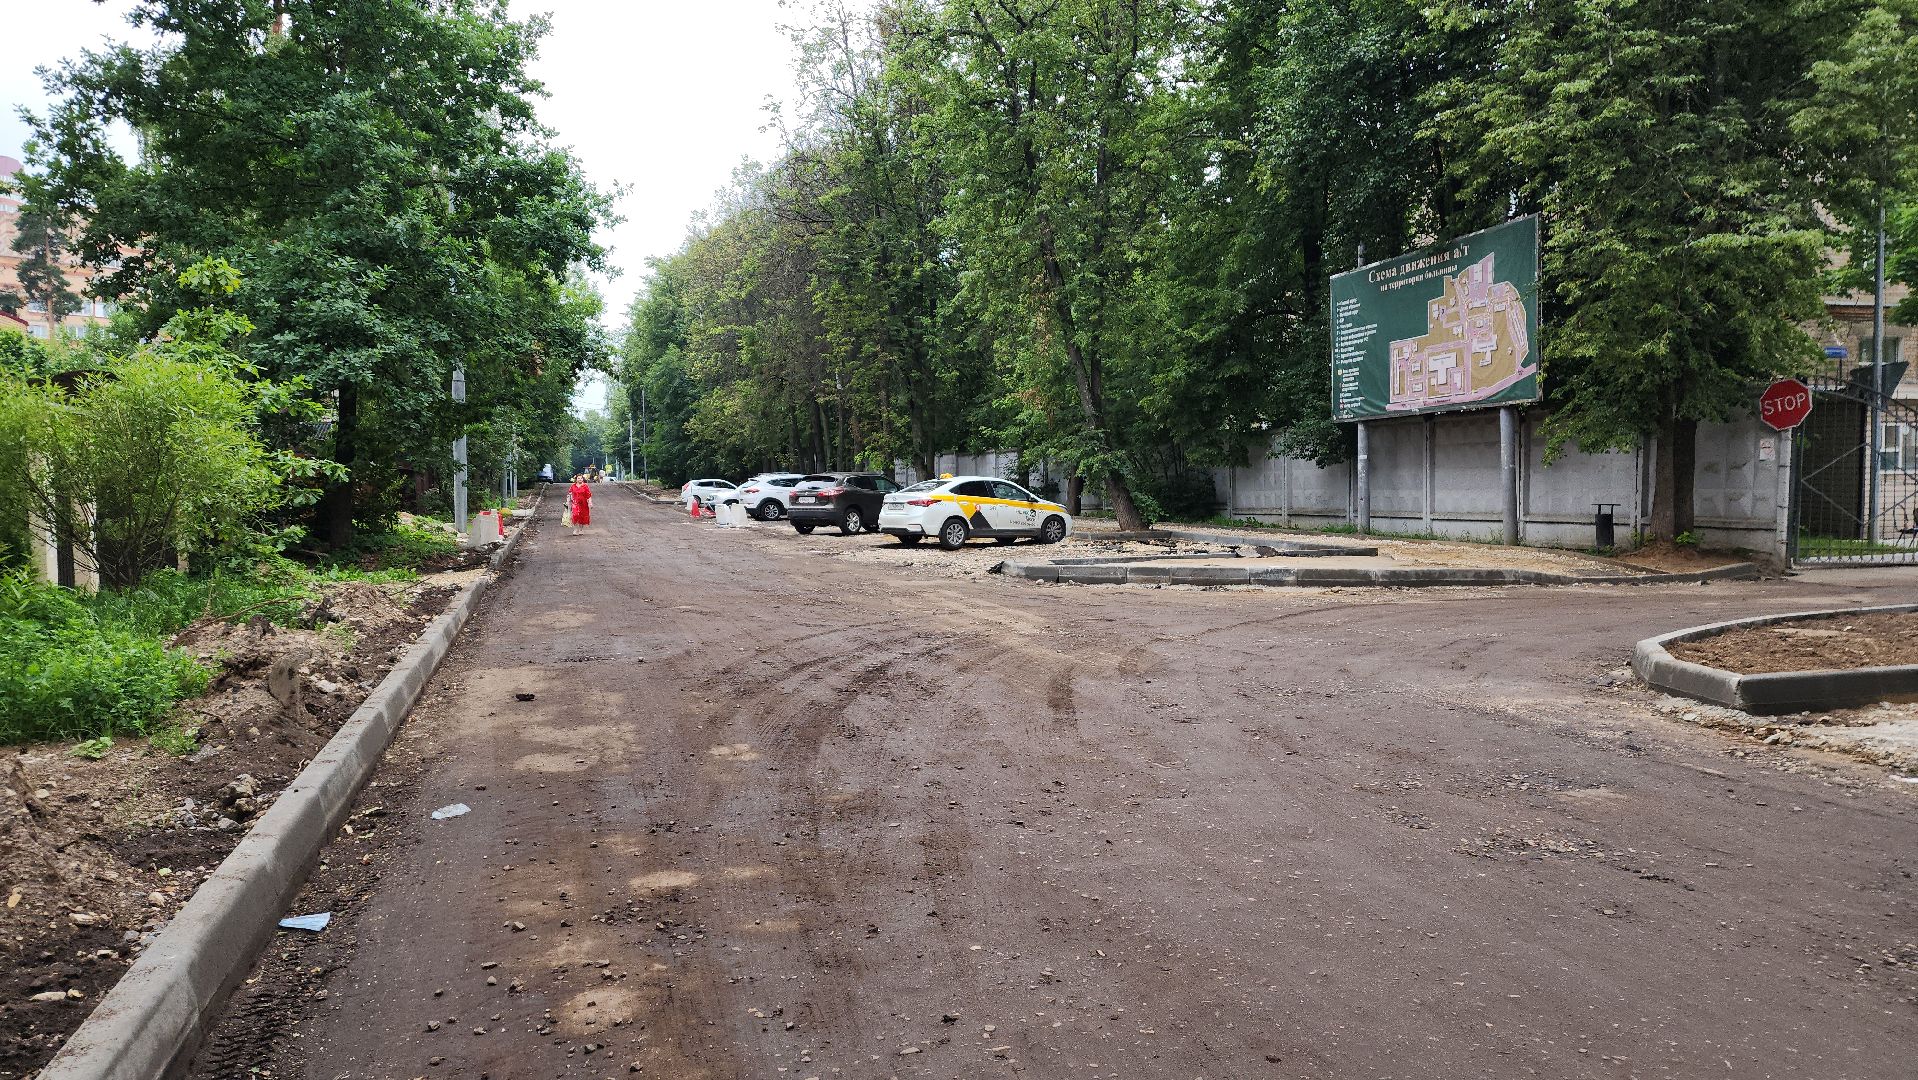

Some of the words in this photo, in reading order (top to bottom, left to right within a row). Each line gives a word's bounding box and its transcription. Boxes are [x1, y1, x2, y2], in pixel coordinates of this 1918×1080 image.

[1368, 267, 1397, 283] Схема
[1400, 251, 1450, 276] движения
[1453, 243, 1470, 259] а/т
[1380, 284, 1388, 292] на
[1388, 273, 1424, 290] территории
[1424, 264, 1458, 280] больницы
[1764, 392, 1806, 415] STOP
